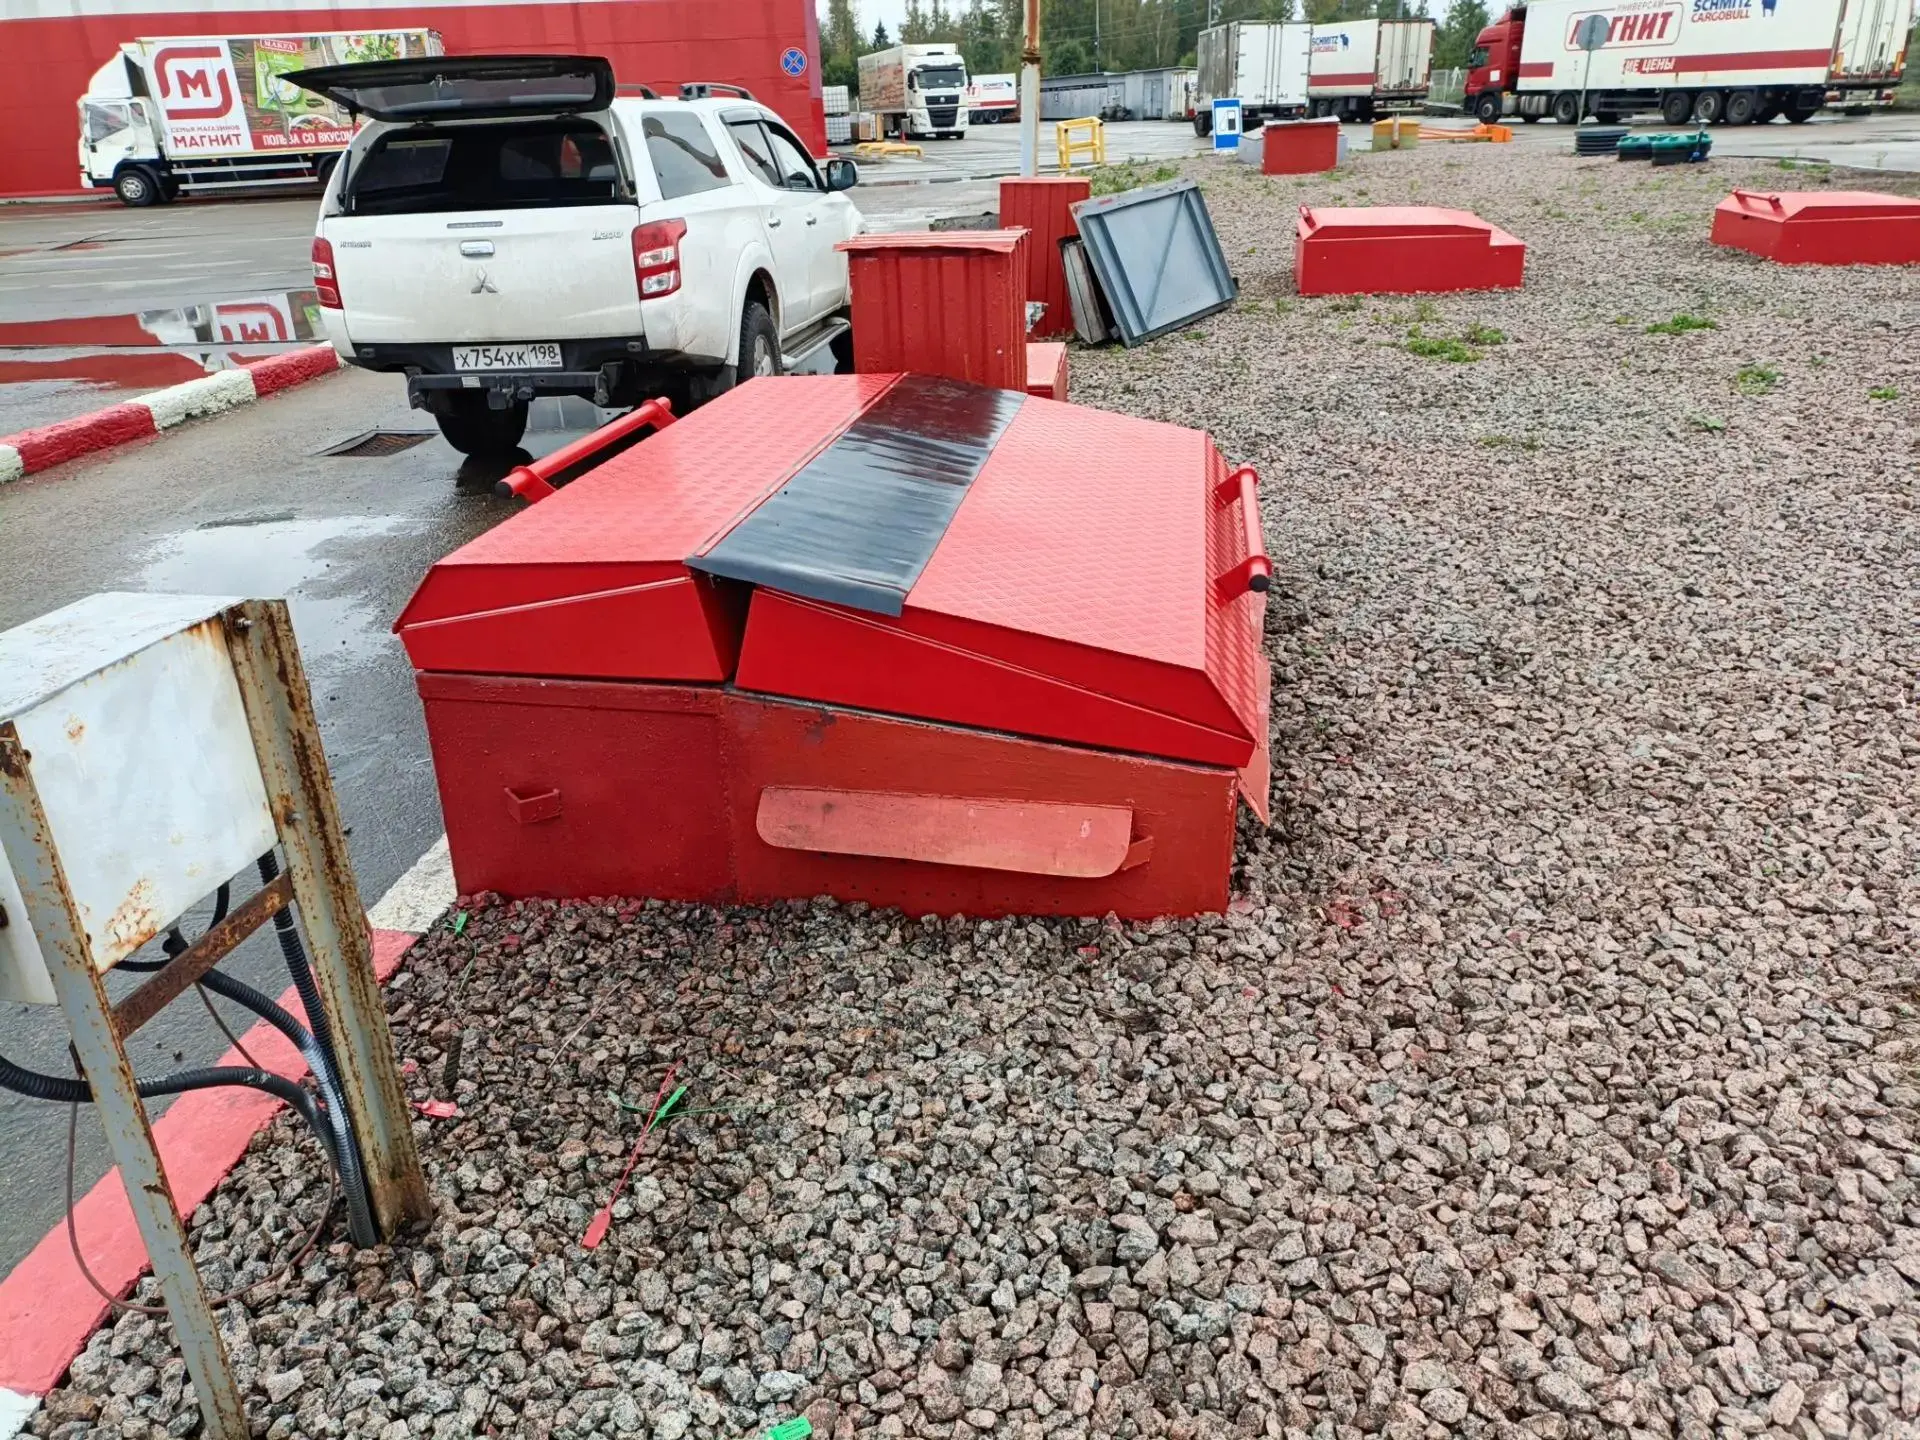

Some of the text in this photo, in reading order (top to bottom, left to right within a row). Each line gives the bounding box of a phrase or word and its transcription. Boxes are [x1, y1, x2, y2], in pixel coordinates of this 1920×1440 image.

[1691, 9, 1750, 23] CARGOBULL
[1569, 11, 1674, 45] ГНИТ
[1642, 58, 1675, 73] ЦЕНЫ
[173, 134, 242, 148] МАГНИТ
[262, 134, 300, 146] ПОЛЬЗА
[302, 132, 316, 144] СО
[460, 345, 556, 368] Х754ХК 198
